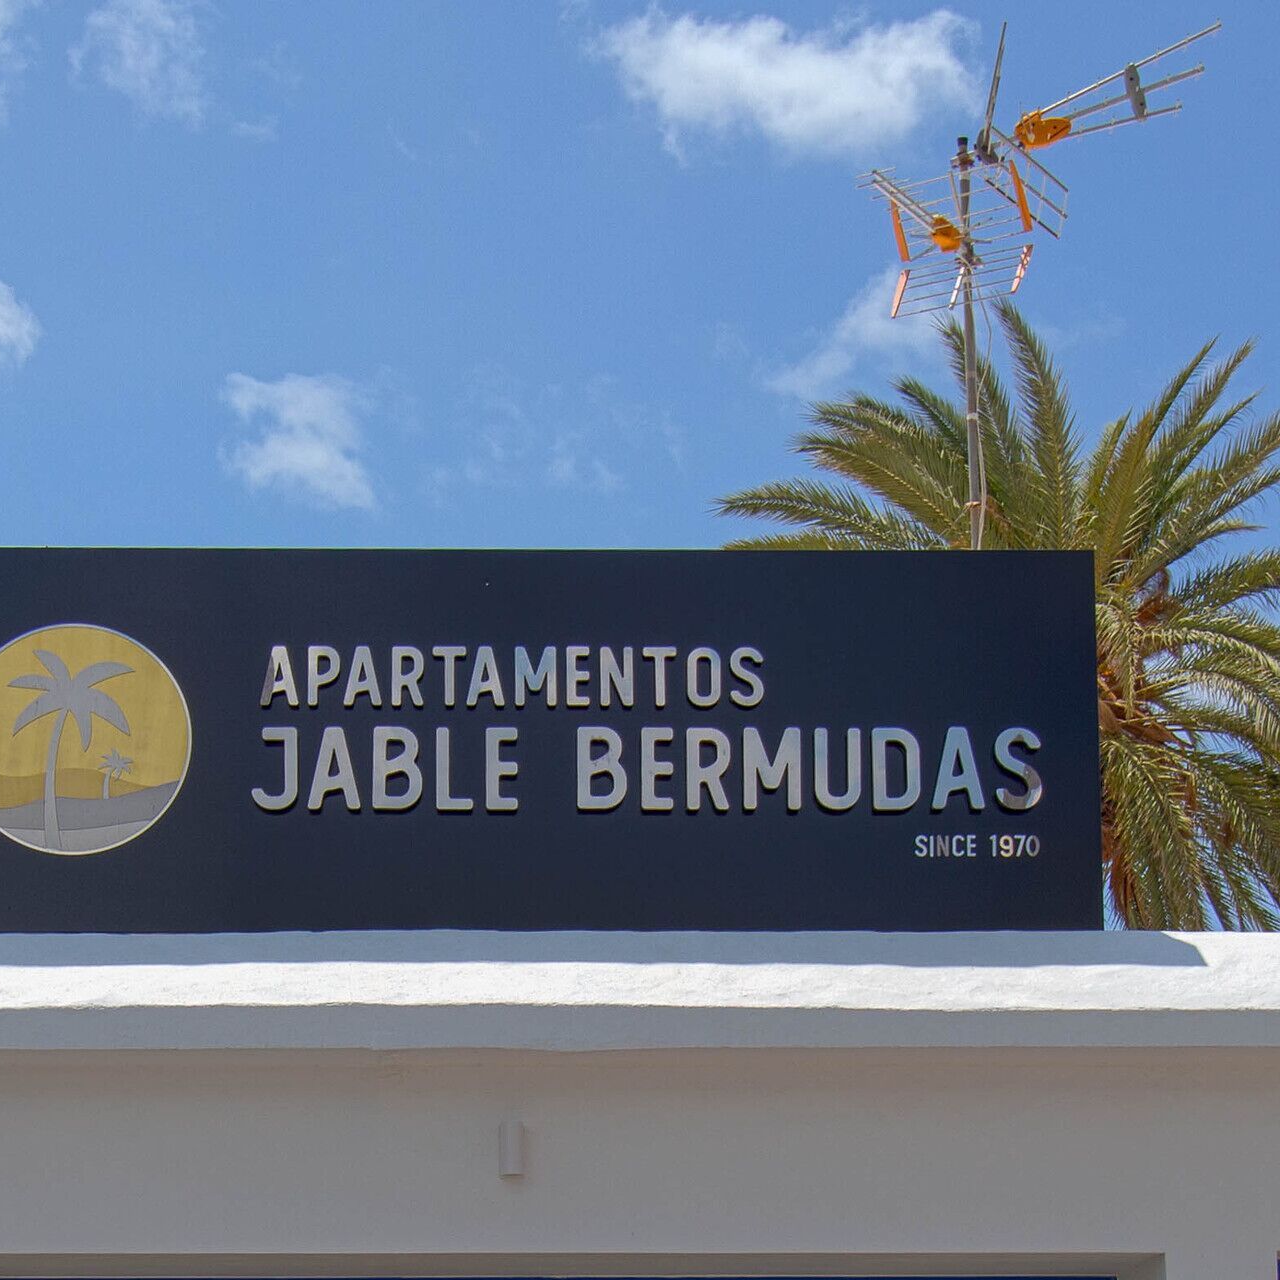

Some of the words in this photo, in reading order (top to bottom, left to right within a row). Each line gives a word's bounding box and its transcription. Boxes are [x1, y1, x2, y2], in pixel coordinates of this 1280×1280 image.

[259, 644, 765, 708] APARTAMENTOS
[250, 725, 520, 812] JABLE
[576, 725, 1043, 812] BERMUDAS
[914, 834, 977, 858] SINCE
[989, 834, 1041, 858] 1970
